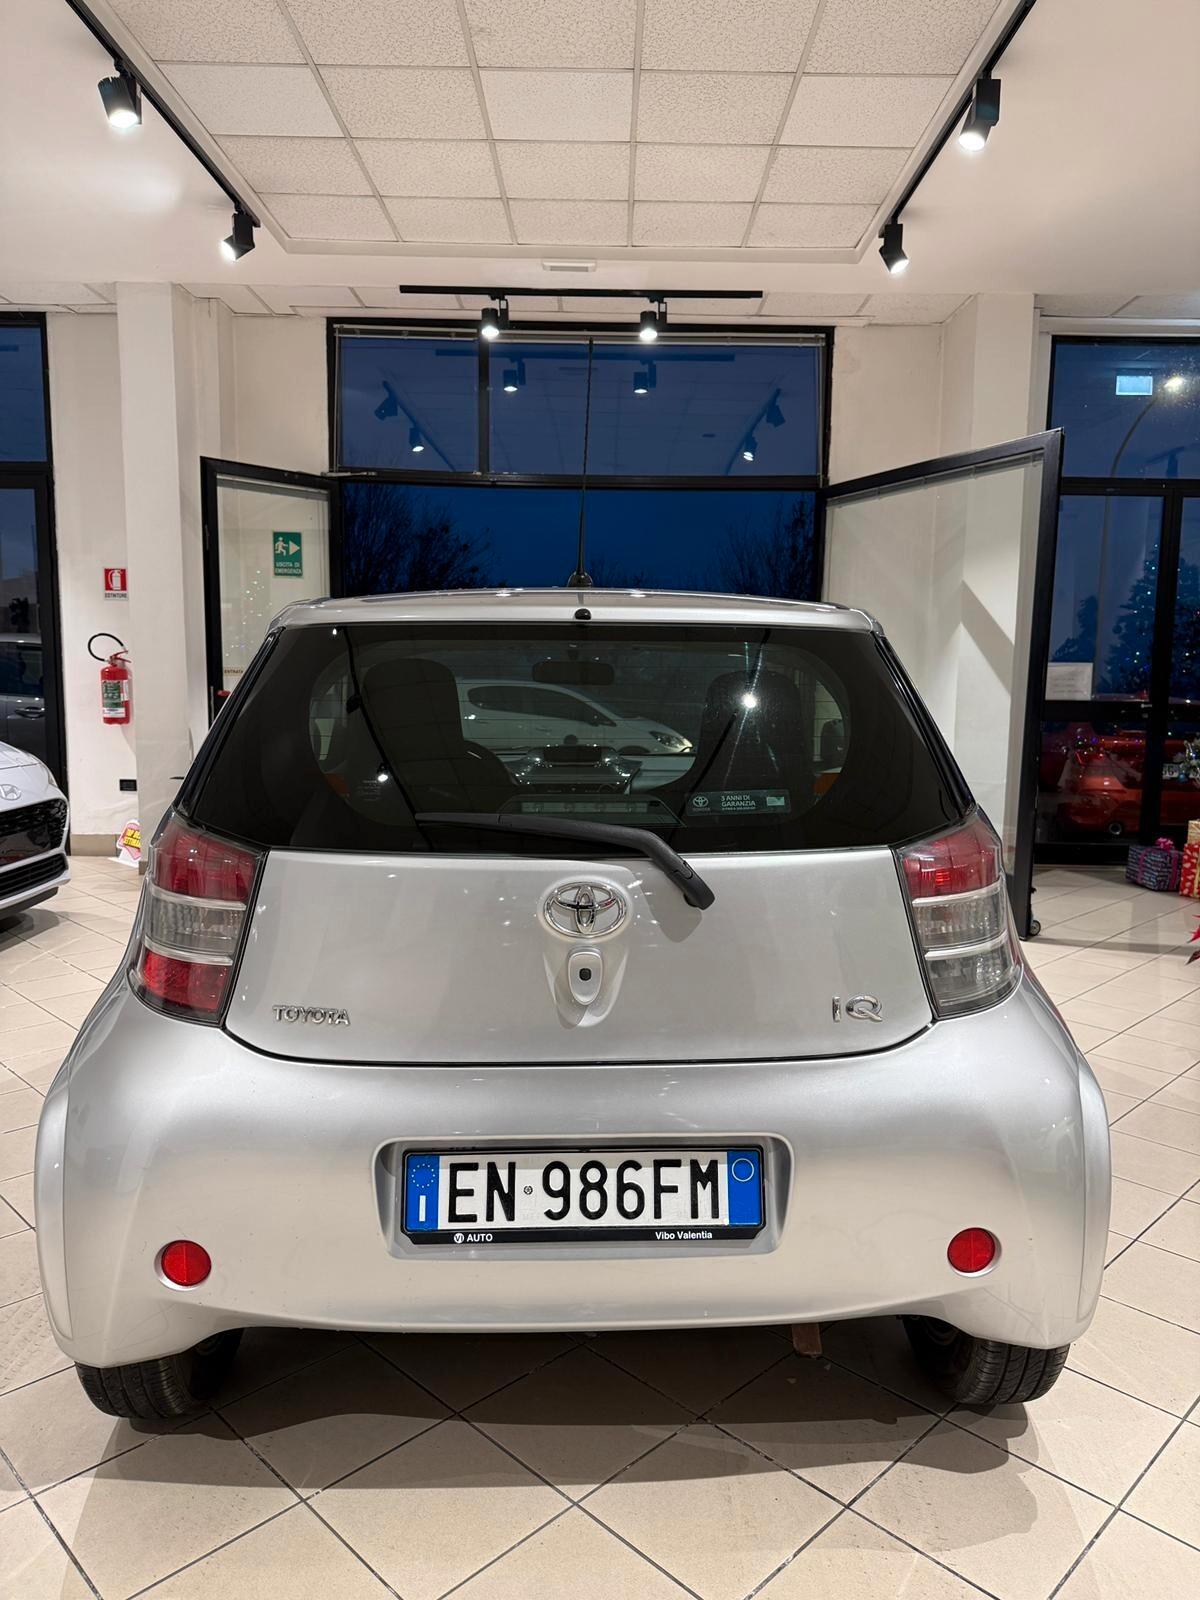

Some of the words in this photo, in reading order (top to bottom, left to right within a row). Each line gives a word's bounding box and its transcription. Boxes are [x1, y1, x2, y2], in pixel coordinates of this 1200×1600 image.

[272, 1004, 351, 1026] TOYOTA
[448, 1161, 516, 1223] EN
[542, 1159, 719, 1221] 986FM
[466, 1233, 493, 1243] AUTO
[655, 1231, 675, 1240] Vibo
[676, 1230, 713, 1240] Valentia
